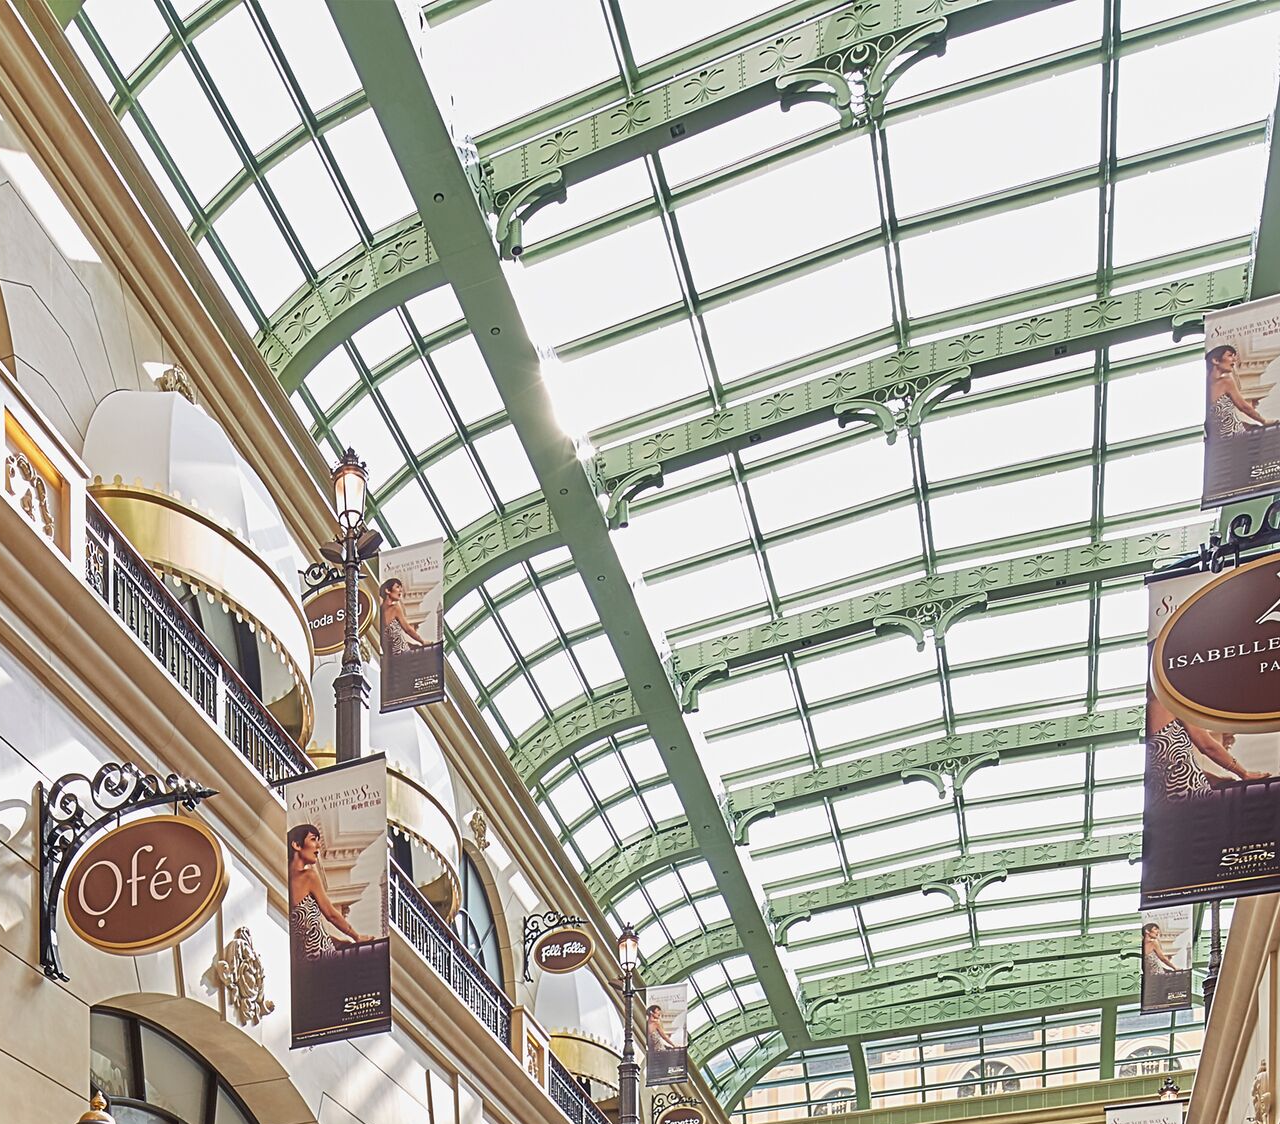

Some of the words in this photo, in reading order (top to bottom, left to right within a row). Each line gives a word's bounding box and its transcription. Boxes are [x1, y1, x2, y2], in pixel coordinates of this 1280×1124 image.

[292, 793, 319, 810] SHOP
[320, 792, 341, 803] YOUR
[343, 787, 359, 798] WAY
[329, 797, 355, 809] HOTEL
[357, 784, 381, 801] STAY
[1220, 849, 1276, 866] Sands
